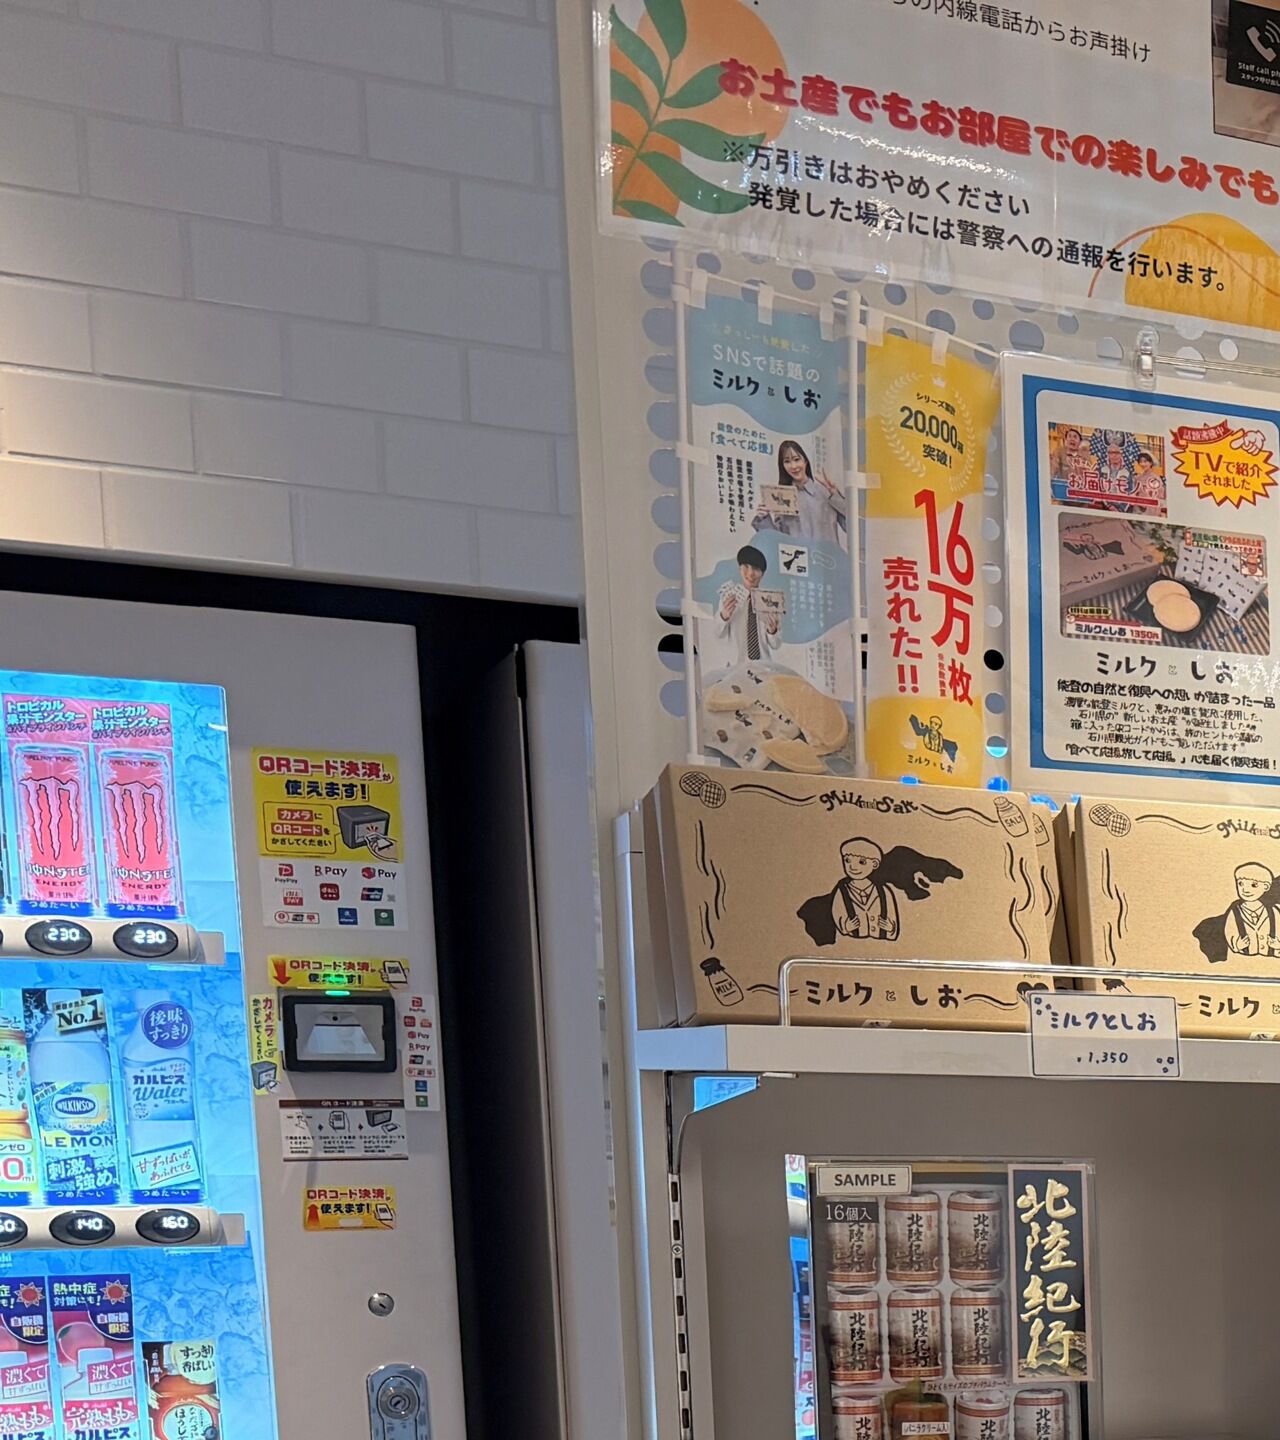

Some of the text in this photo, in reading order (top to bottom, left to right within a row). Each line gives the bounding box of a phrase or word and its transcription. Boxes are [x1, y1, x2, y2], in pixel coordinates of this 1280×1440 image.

[713, 344, 820, 382] SNSで話題の
[1190, 448, 1264, 480] TVで紹介
[1201, 473, 1252, 492] されました
[272, 837, 332, 847] かざしてください
[48, 929, 80, 940] 230
[133, 930, 166, 942] 230
[149, 1008, 182, 1026] 後味
[1049, 1010, 1158, 1033] ミルクとしお
[149, 1023, 189, 1041] すっきり
[133, 1074, 186, 1085] カルピス
[132, 1085, 187, 1101] Water
[56, 1098, 96, 1115] WILKINSON
[44, 1136, 114, 1148] LEMON
[834, 1173, 897, 1187] SAMPLE
[825, 1203, 872, 1222] 16個入
[1016, 1178, 1083, 1369] 北陸紀行
[74, 1429, 132, 1440] カルピス
